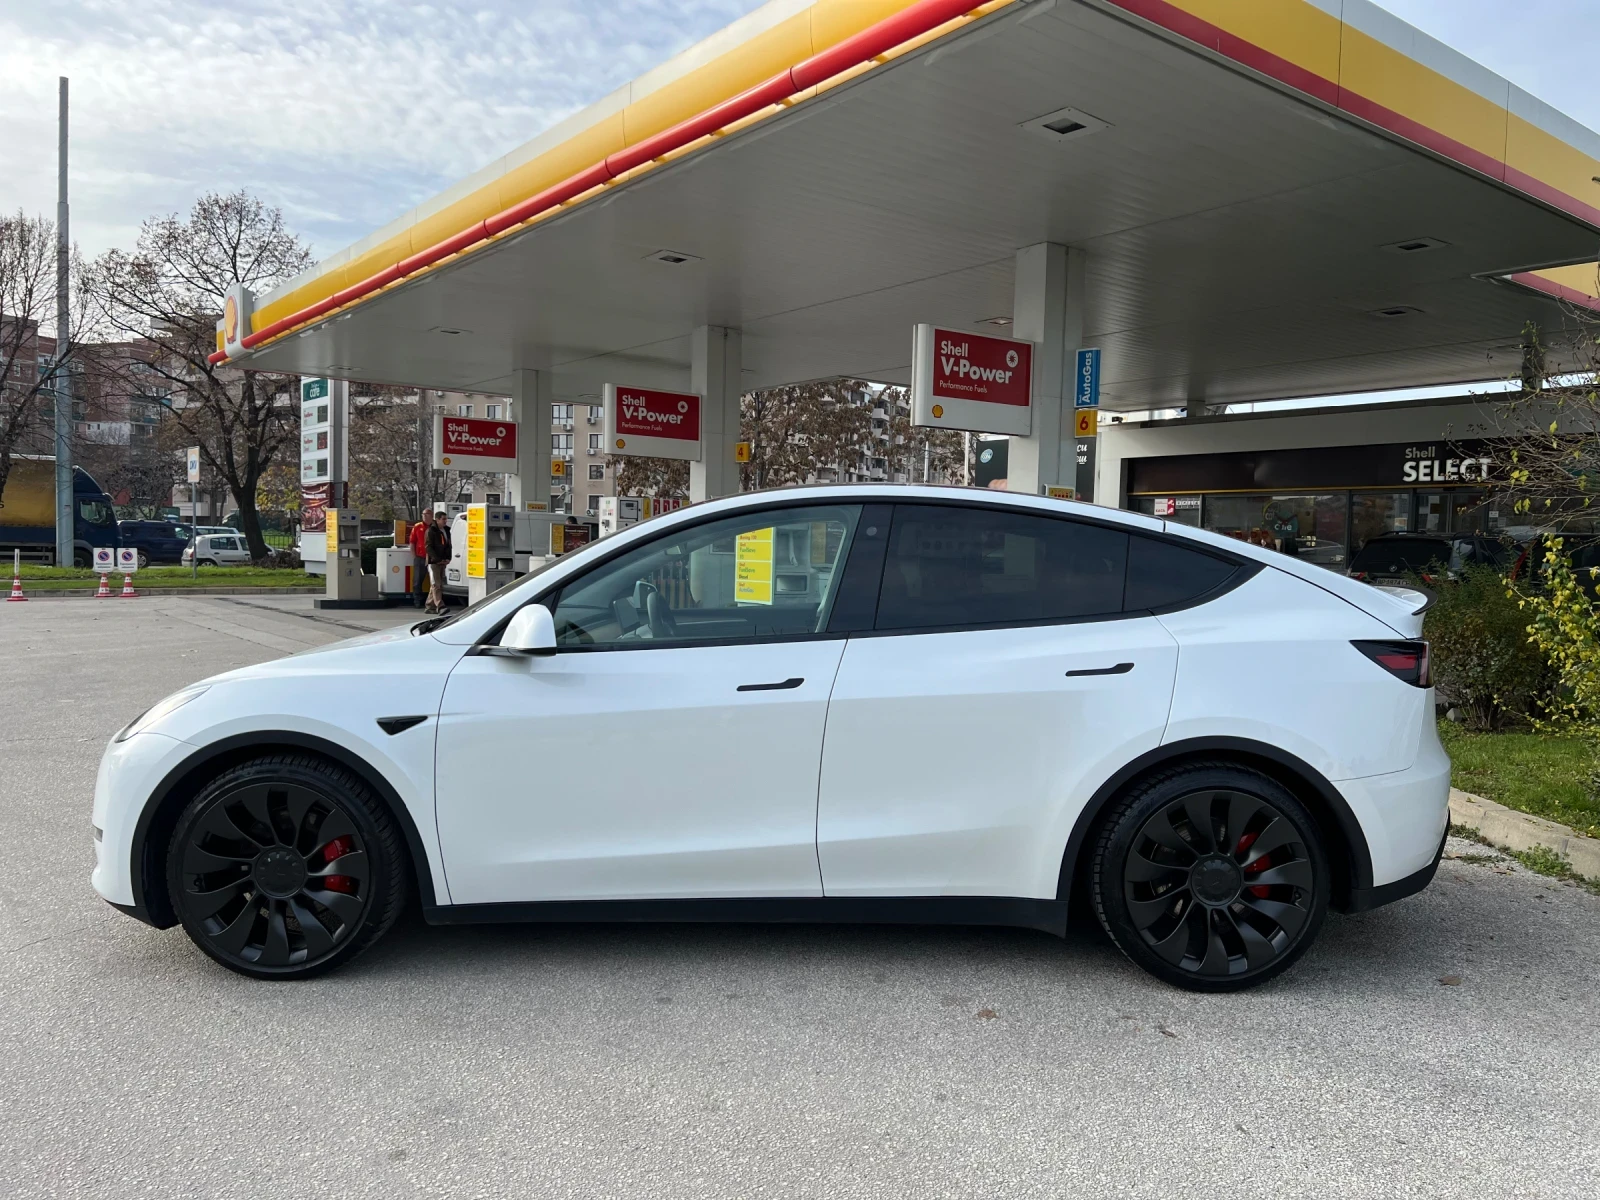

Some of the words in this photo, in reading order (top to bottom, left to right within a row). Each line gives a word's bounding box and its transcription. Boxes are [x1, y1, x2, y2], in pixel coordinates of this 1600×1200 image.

[941, 340, 968, 357] Shell
[941, 356, 1012, 384] V-Power
[1082, 352, 1092, 403] AutoGas
[940, 380, 973, 392] Performance
[974, 385, 988, 393] Fuels
[622, 395, 646, 406] Shell
[622, 406, 683, 424] V-Power
[448, 424, 468, 432] Shell
[622, 422, 650, 430] Performance
[1080, 416, 1088, 430] 6
[448, 432, 502, 446] V-Power
[738, 447, 744, 458] 4
[1405, 446, 1436, 458] Shell
[554, 464, 561, 472] 2
[1402, 458, 1492, 482] SELECT
